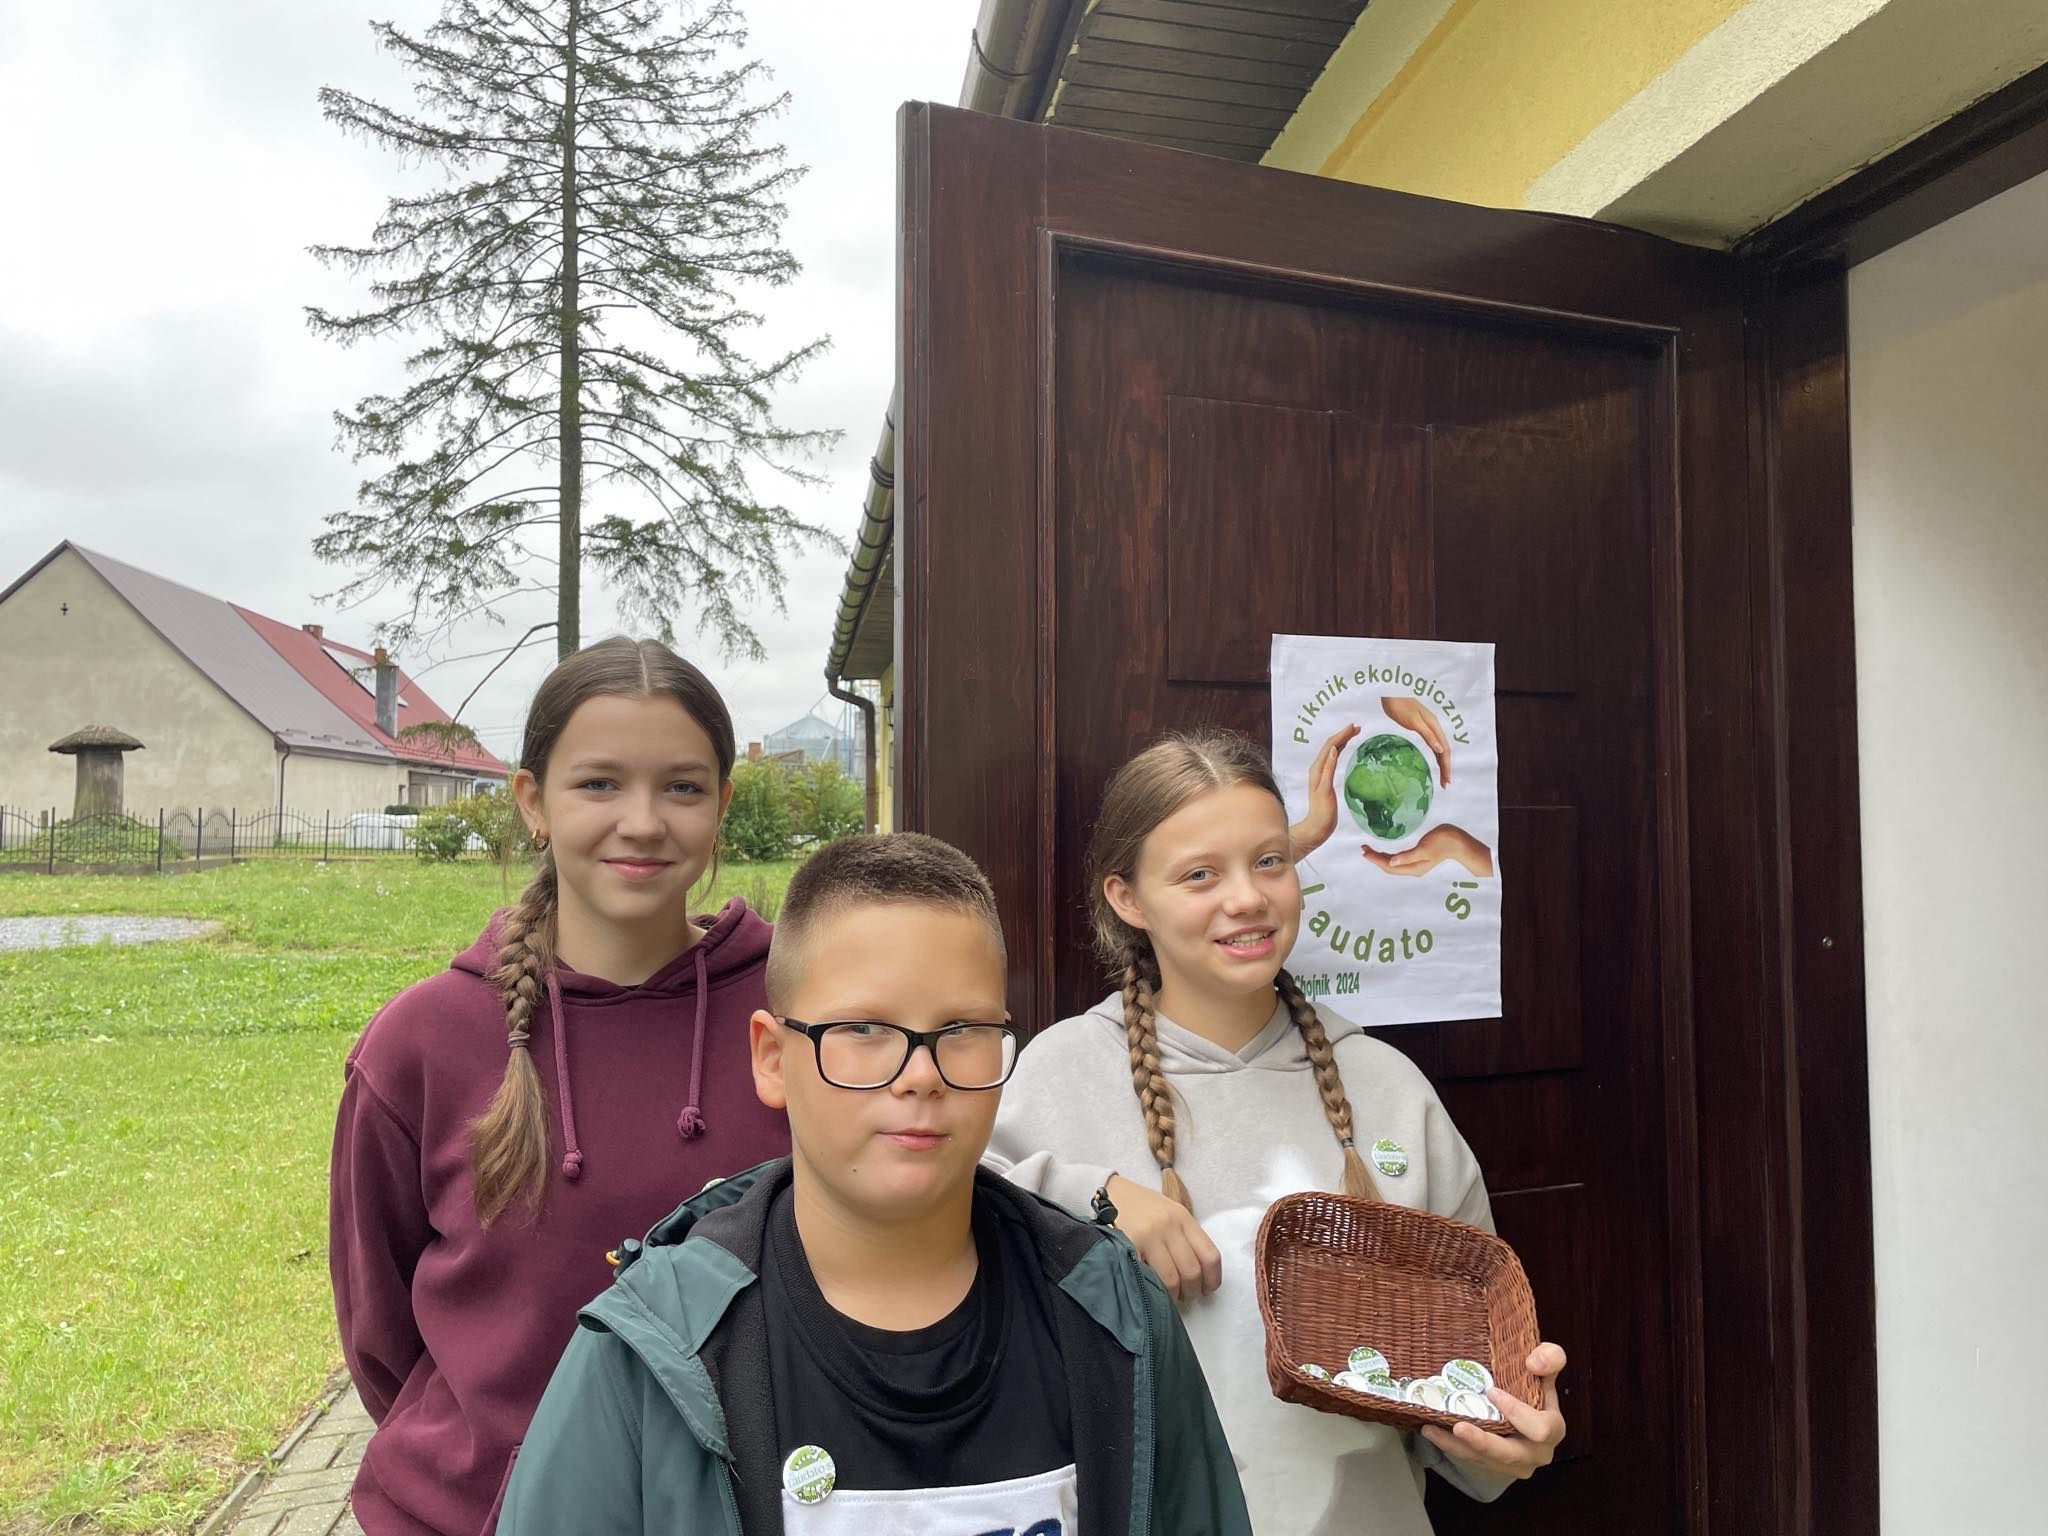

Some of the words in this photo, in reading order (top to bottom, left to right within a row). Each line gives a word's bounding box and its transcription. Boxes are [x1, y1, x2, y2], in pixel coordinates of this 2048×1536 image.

[1293, 674, 1347, 744] Piknik
[1354, 664, 1470, 745] ekologiczny
[1445, 881, 1479, 920] Si
[1336, 972, 1360, 994] 2024
